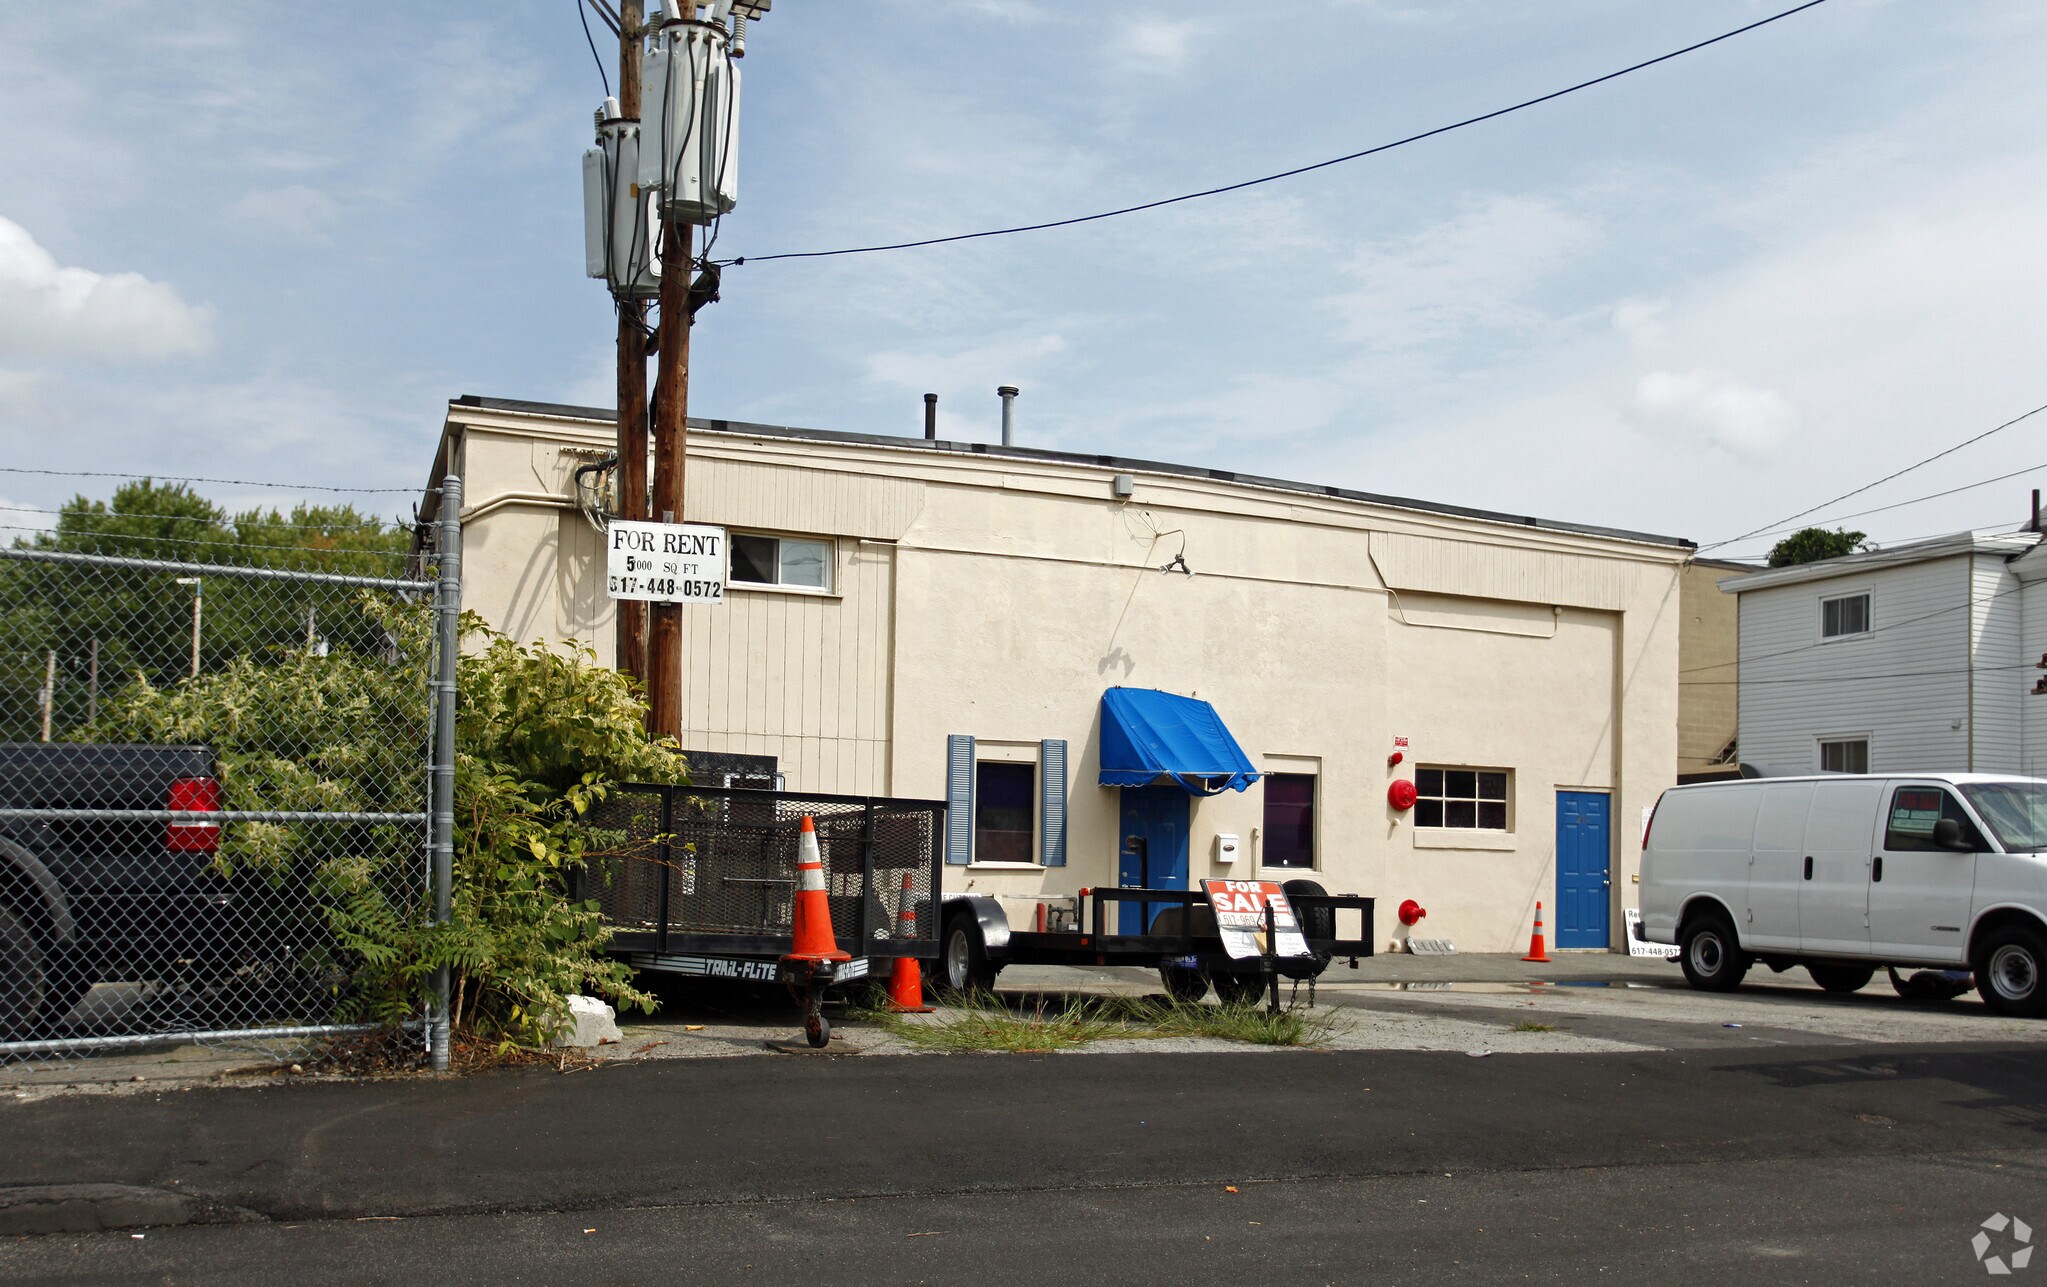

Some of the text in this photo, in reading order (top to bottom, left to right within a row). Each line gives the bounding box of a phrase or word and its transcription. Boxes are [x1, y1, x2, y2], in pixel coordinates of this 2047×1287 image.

[613, 529, 720, 556] FOR RENT
[662, 561, 678, 575] SQ
[683, 563, 699, 575] FT
[1225, 881, 1262, 892] FOR
[1212, 892, 1288, 912] SALE
